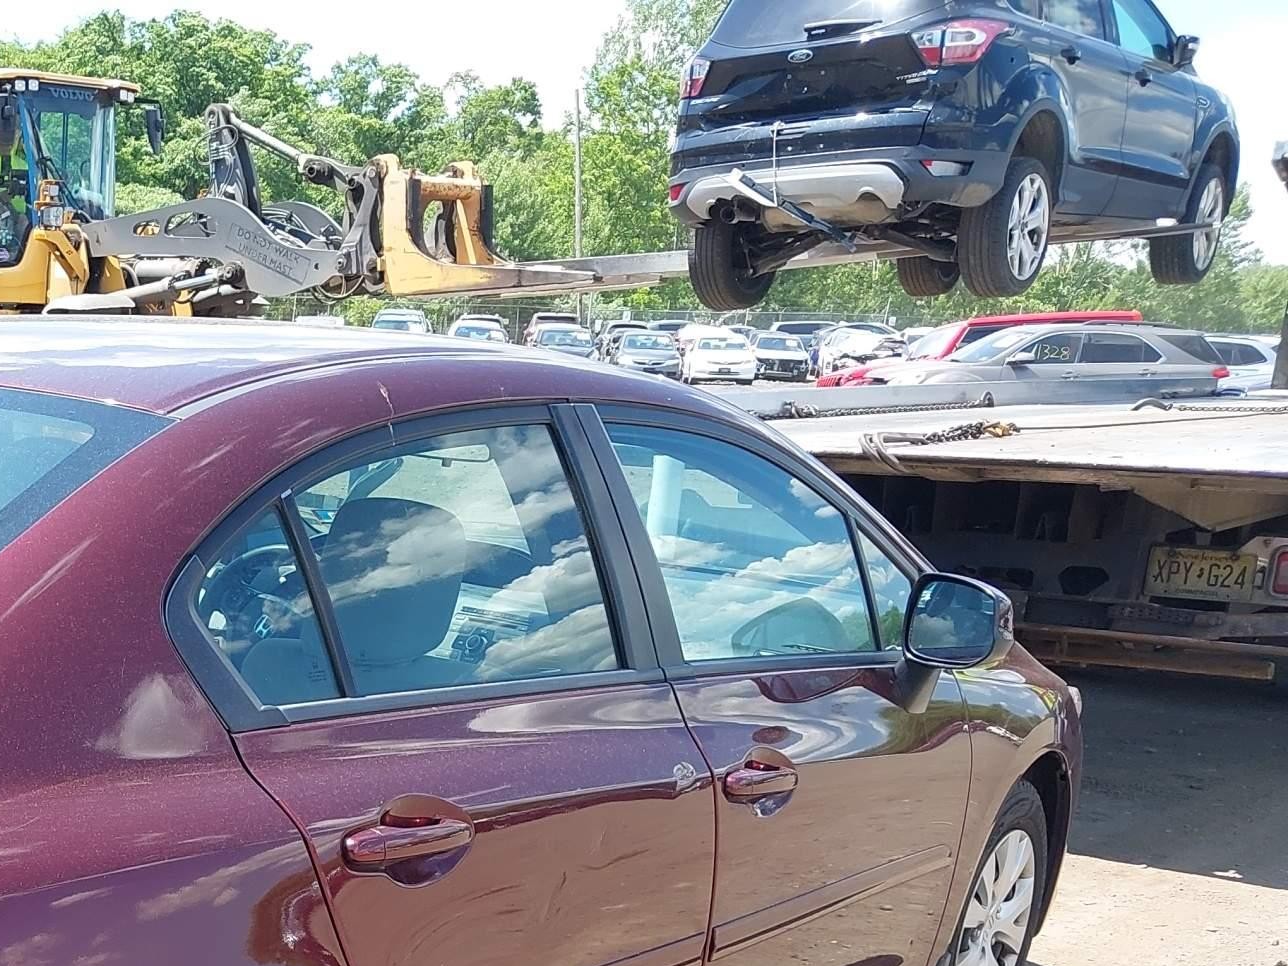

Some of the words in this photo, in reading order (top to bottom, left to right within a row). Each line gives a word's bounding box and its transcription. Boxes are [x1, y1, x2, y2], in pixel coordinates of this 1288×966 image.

[47, 87, 94, 102] VOLVO
[237, 228, 252, 240] DO
[253, 234, 271, 251] NOT
[274, 244, 301, 264] WALK
[238, 243, 269, 264] UNDER
[1037, 343, 1070, 361] 1328
[1154, 559, 1194, 585] XPY
[1206, 563, 1247, 590] G24
